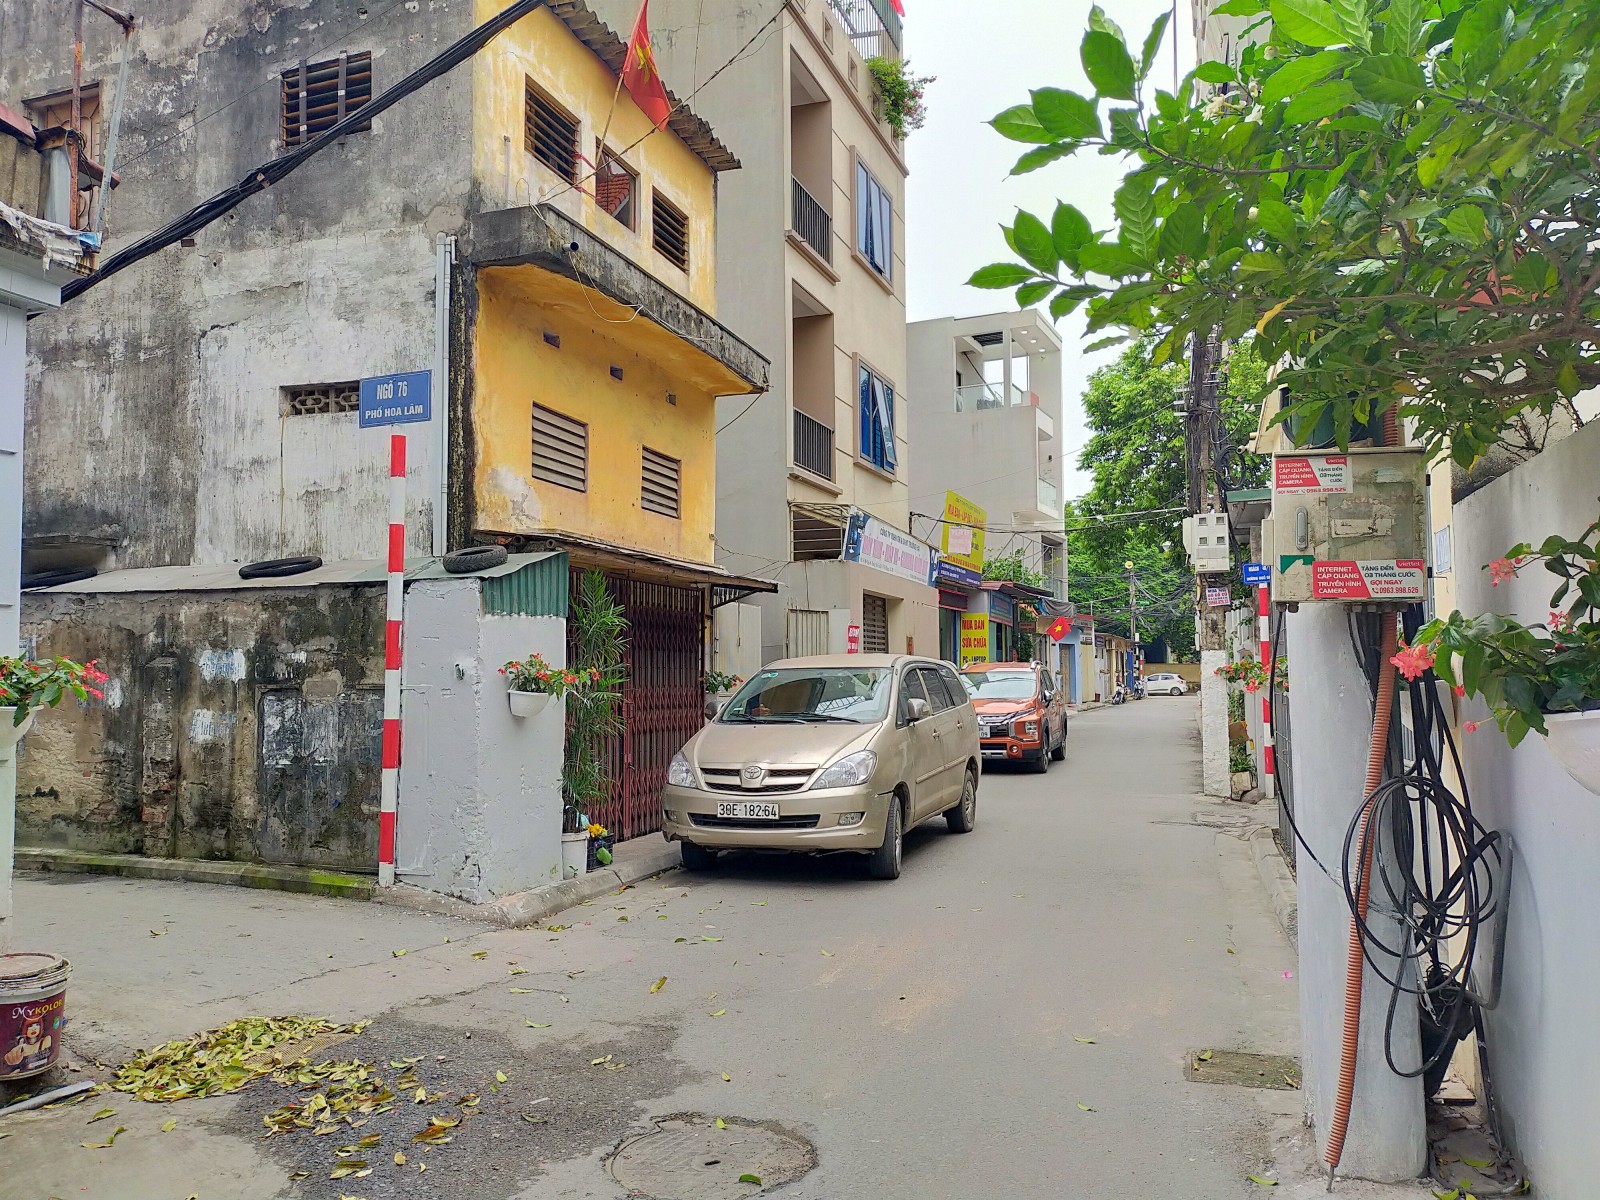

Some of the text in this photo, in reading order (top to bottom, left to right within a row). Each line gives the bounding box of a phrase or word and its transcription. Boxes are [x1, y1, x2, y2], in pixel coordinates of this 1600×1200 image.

[377, 378, 408, 400] NGÕ 76
[365, 403, 423, 419] PHỐ HOA LÂM
[962, 617, 985, 631] MUA BÁN
[962, 634, 987, 649] SỬA CHỮA
